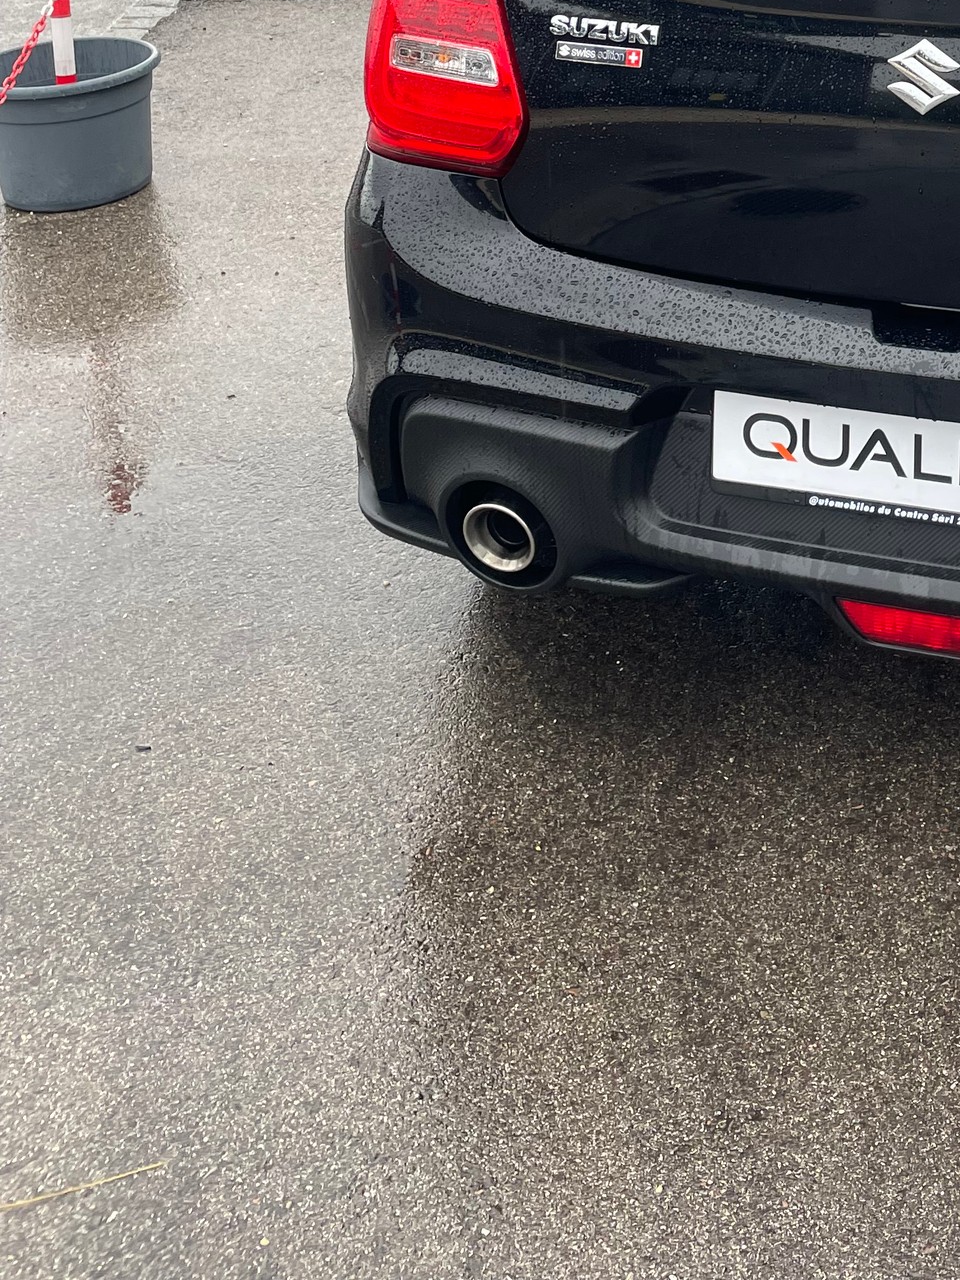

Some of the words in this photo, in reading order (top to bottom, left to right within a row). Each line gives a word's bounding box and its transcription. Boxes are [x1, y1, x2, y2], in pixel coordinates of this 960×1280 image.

[549, 14, 660, 46] SUZUKI
[571, 48, 596, 60] swiss
[597, 50, 625, 62] edition
[877, 505, 892, 516] du
[894, 507, 930, 521] Centre
